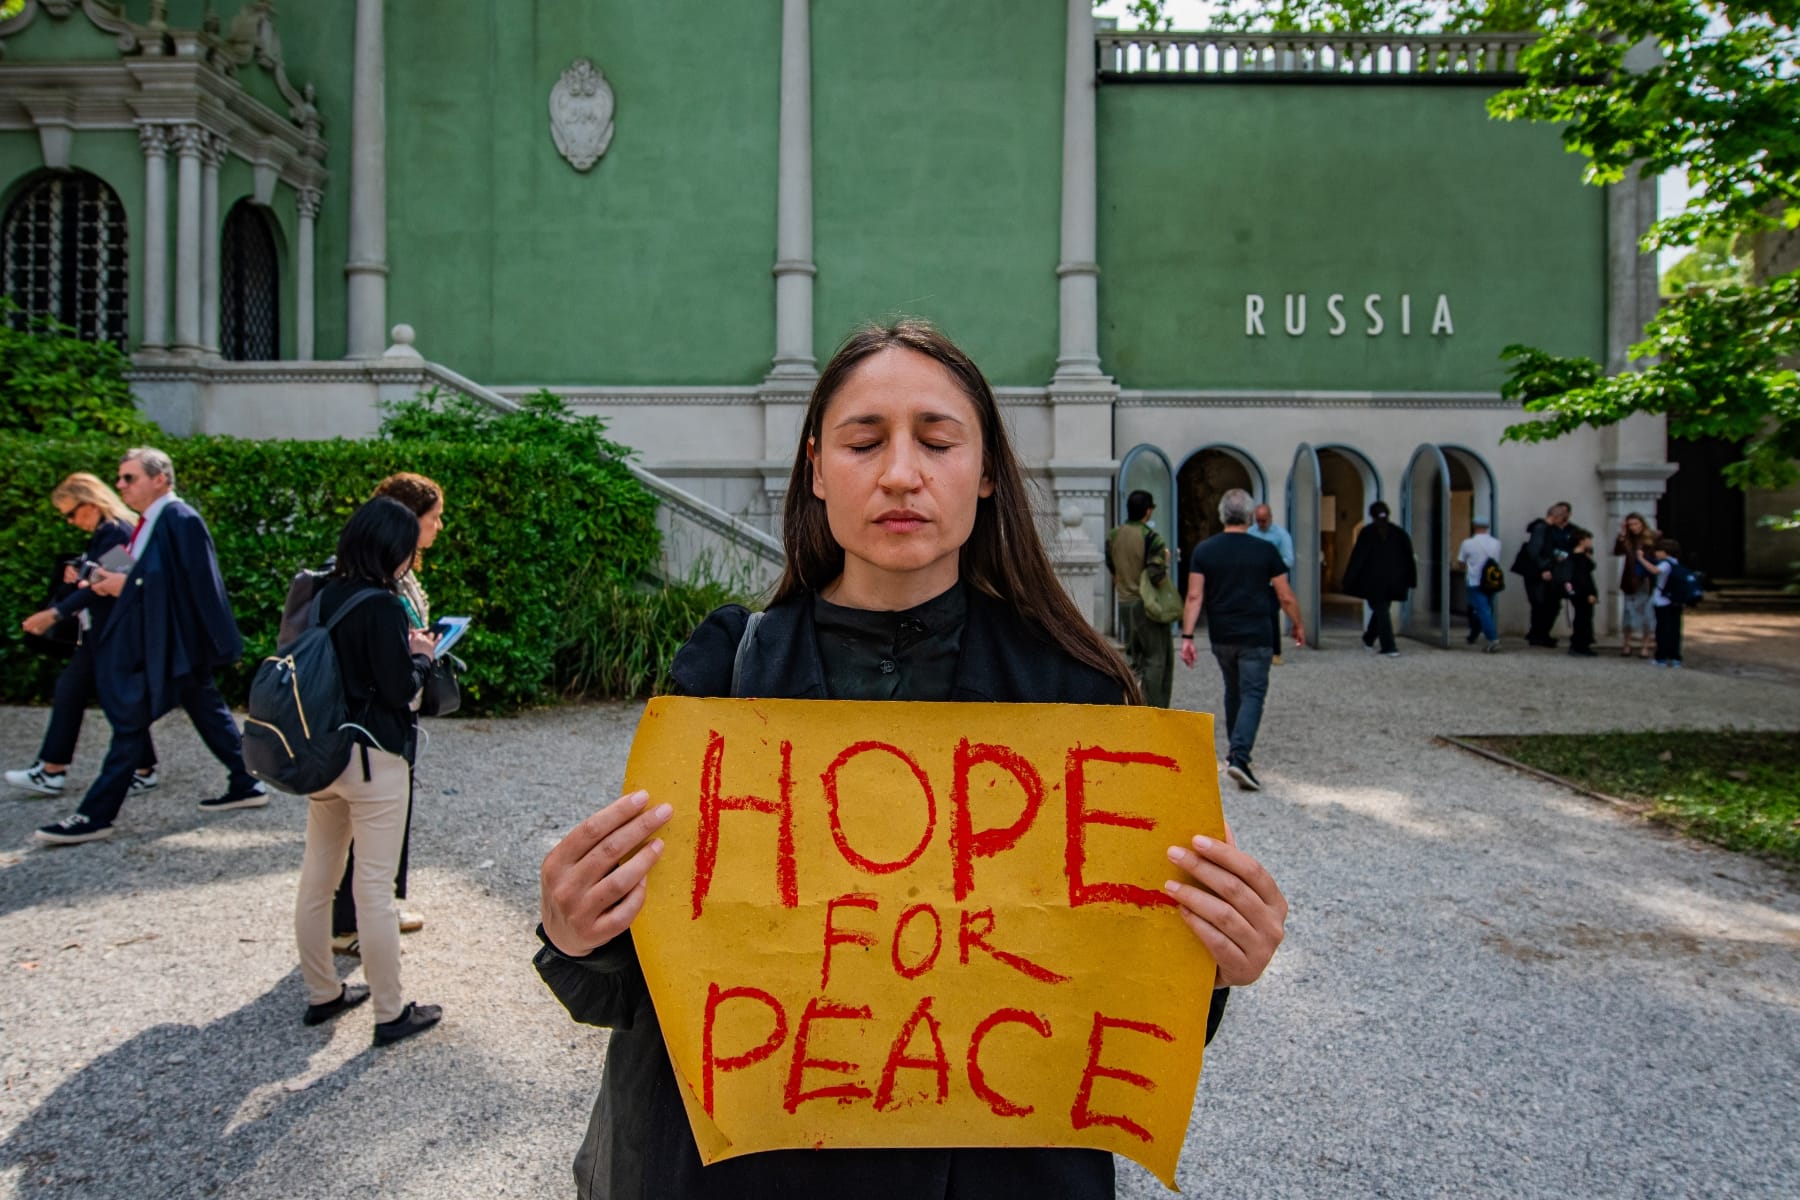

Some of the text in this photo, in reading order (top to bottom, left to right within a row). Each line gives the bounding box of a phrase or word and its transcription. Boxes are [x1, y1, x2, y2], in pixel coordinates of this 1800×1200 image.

[1245, 293, 1455, 336] RUSSIA
[691, 730, 1181, 920] HOPE
[820, 892, 1071, 991] FOR
[700, 981, 1177, 1143] PEACE
